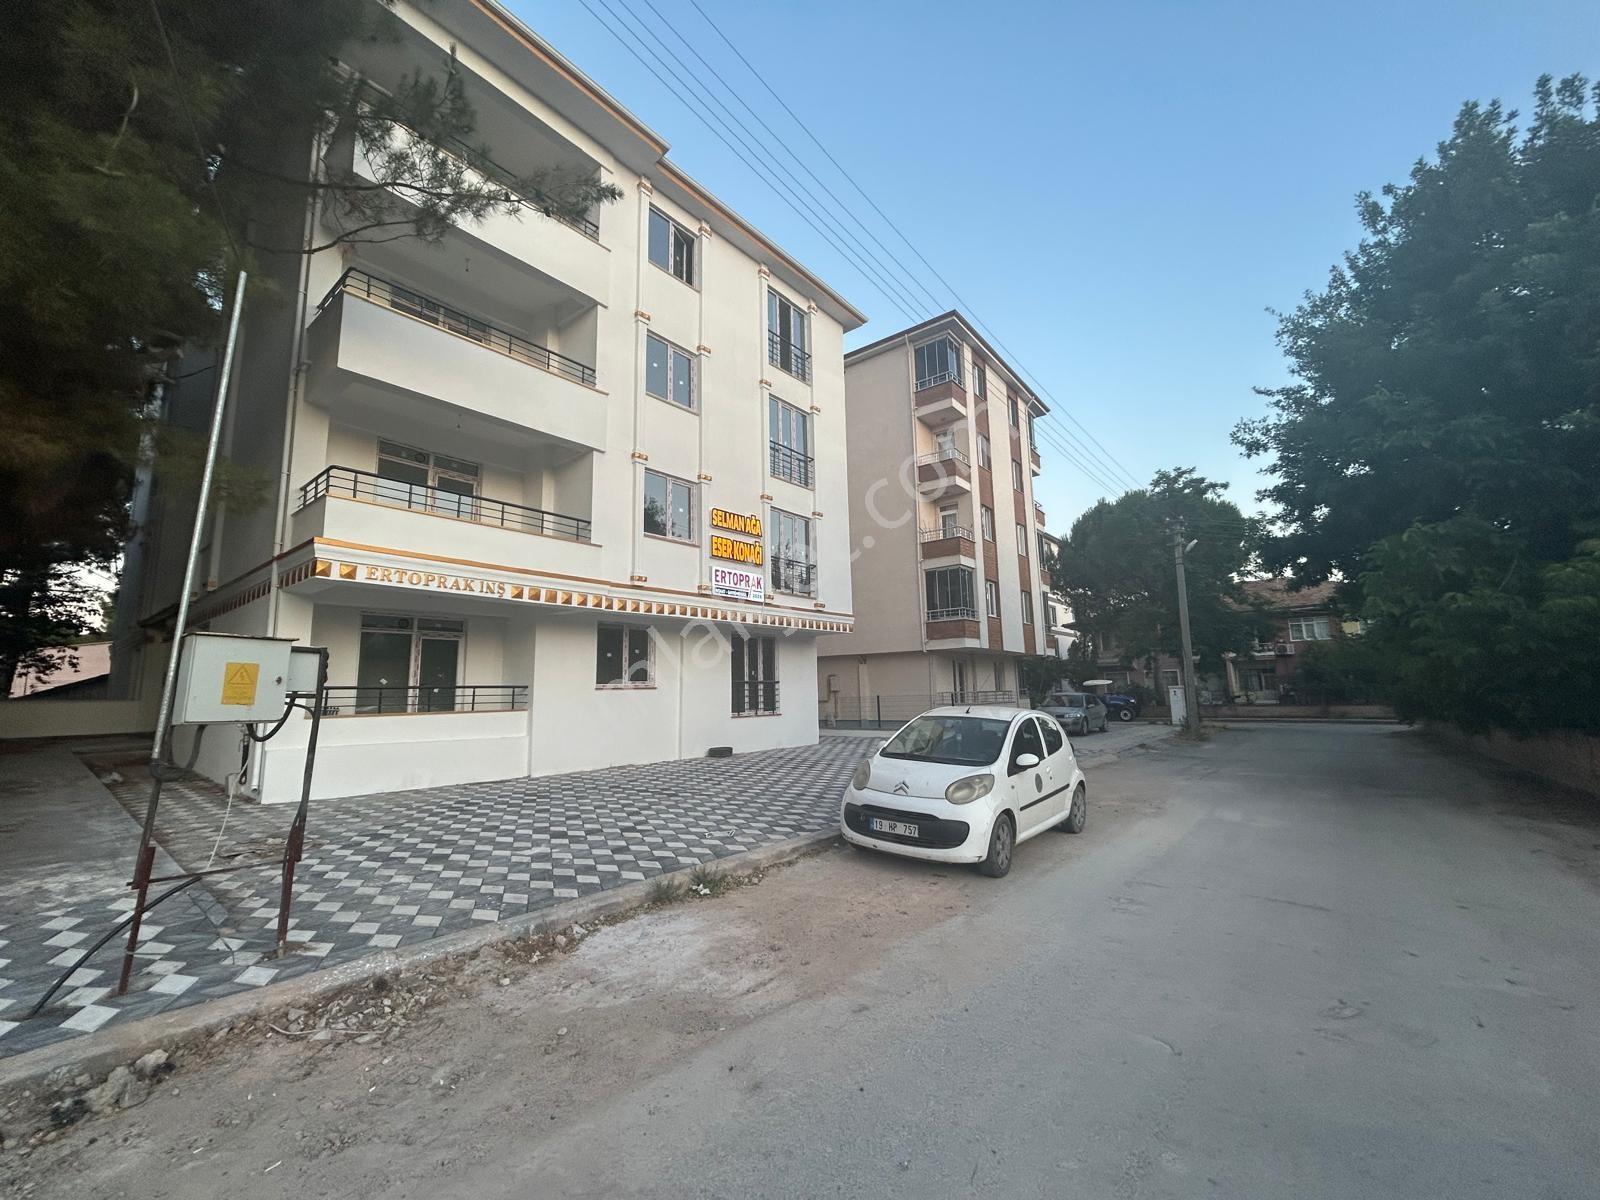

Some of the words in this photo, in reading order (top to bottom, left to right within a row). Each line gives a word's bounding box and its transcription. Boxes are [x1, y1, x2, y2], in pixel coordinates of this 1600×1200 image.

[712, 508, 745, 532] SELMAN
[745, 515, 762, 537] AĞA
[712, 535, 733, 559] ESER
[733, 541, 763, 566] KONAĞI
[365, 566, 475, 592] ERTOPRAK
[714, 568, 762, 590] ERTOPRAK
[875, 820, 883, 830] 19
[903, 824, 917, 835] 757
